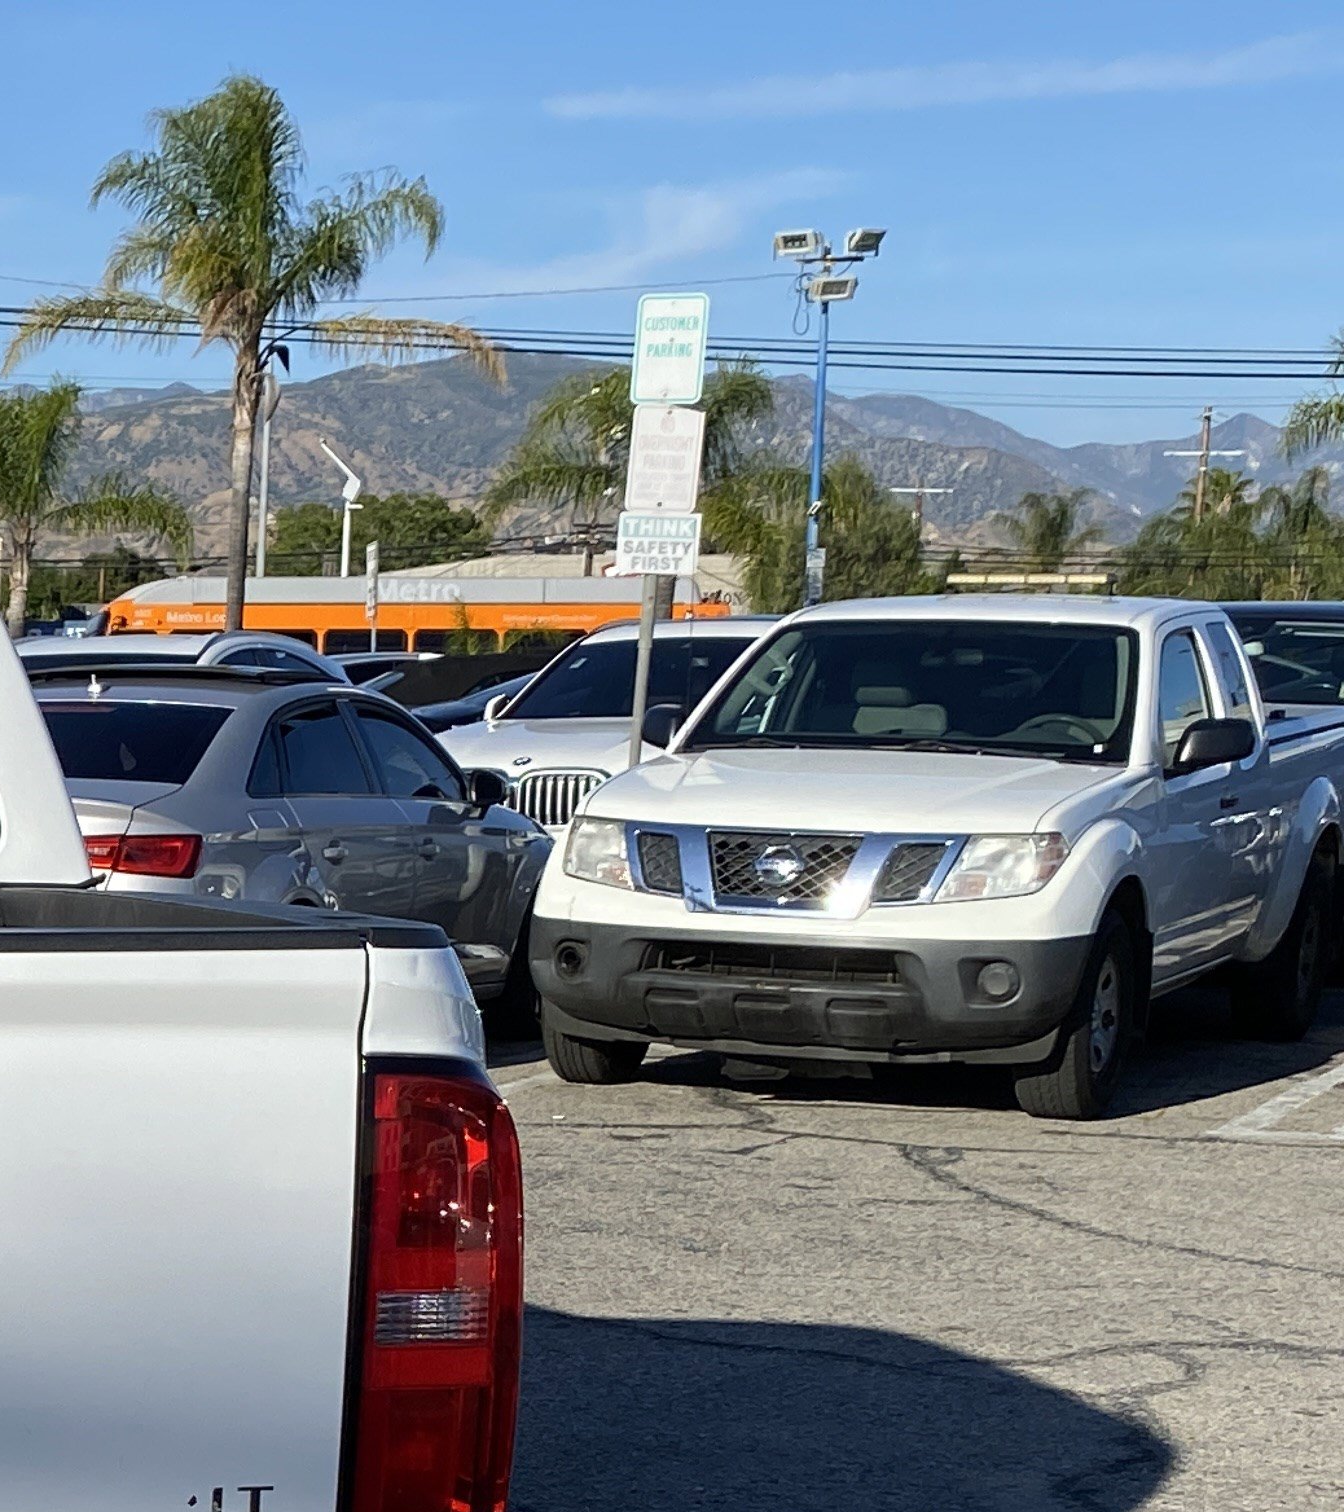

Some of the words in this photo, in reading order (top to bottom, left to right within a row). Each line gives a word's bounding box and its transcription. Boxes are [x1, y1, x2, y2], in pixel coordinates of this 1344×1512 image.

[645, 316, 699, 331] CUSTOMER
[647, 342, 693, 358] PARKING
[625, 518, 696, 537] THINK
[623, 540, 692, 555] SAFETY
[630, 556, 683, 571] FIRST
[377, 578, 461, 601] Metro
[166, 611, 203, 623] Metro
